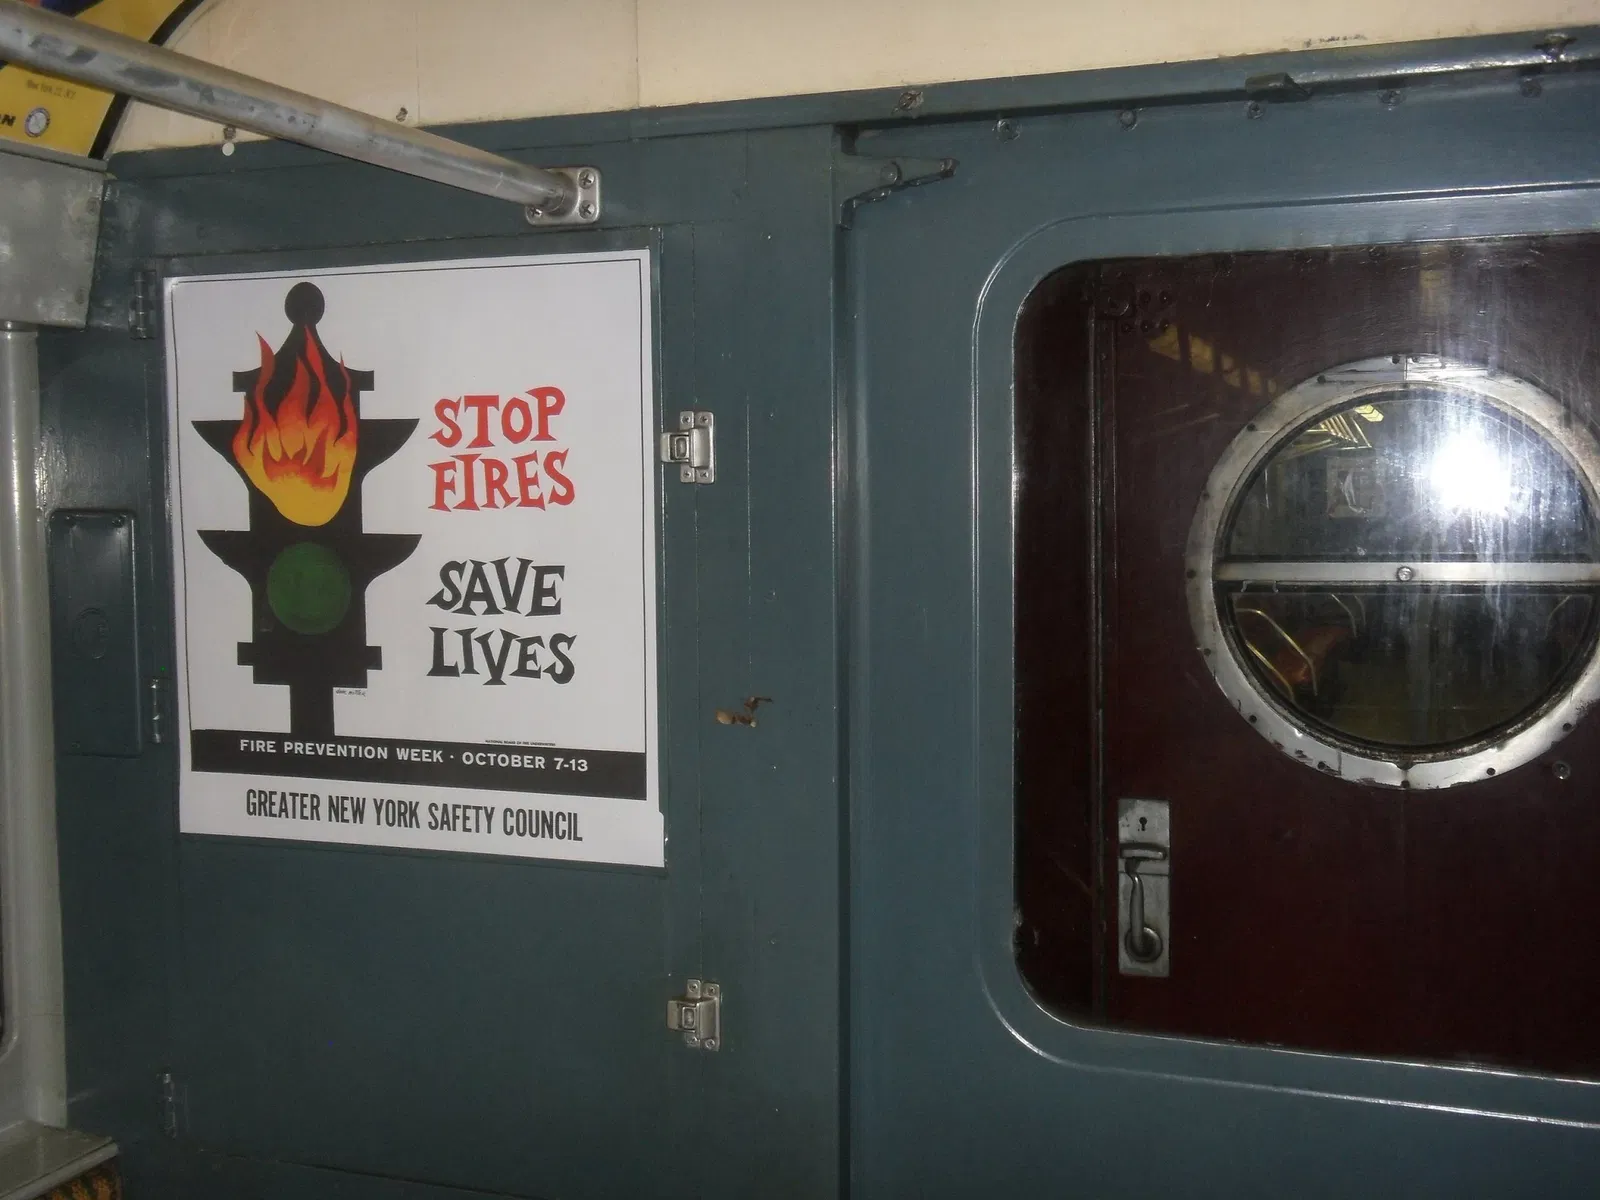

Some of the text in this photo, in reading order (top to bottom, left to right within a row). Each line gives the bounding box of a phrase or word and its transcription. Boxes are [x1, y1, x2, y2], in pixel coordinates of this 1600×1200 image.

[427, 386, 566, 449] STOP
[427, 449, 576, 512] FIRES
[425, 556, 566, 617] SAVE
[426, 626, 578, 686] LIVES
[240, 739, 589, 772] FIRE PREVENTION WEEK OCTOBER 7-13
[246, 788, 583, 842] GREATER NEW YORK SAFETY COUNCIL
